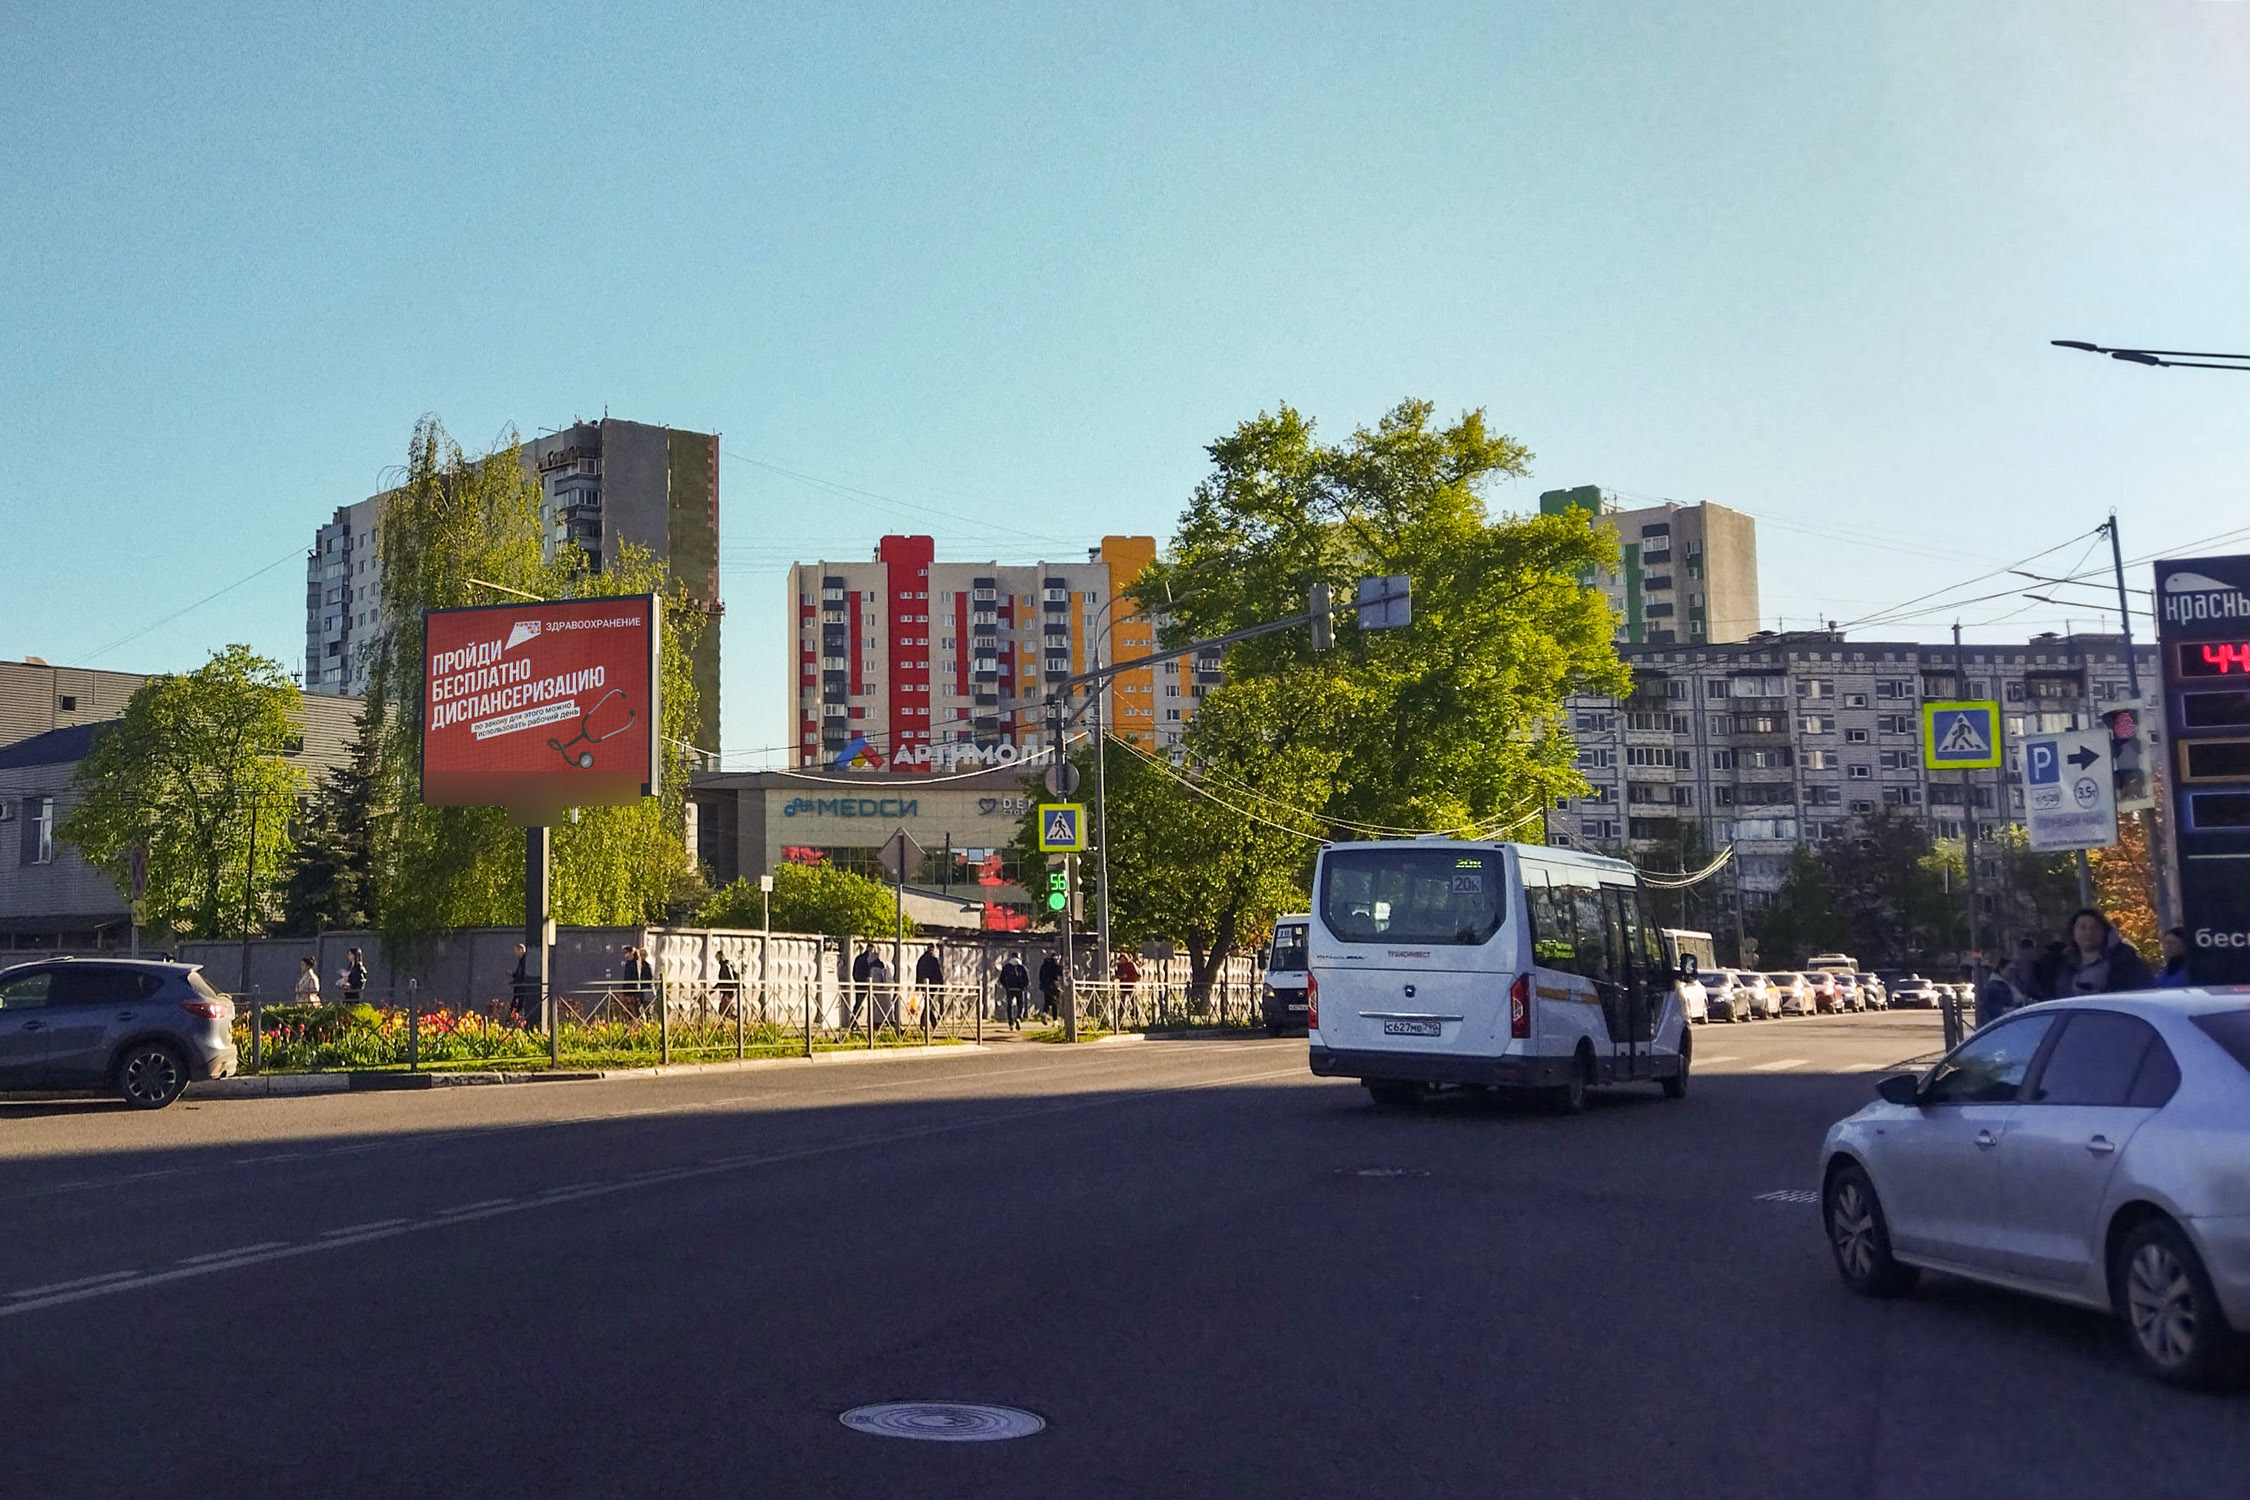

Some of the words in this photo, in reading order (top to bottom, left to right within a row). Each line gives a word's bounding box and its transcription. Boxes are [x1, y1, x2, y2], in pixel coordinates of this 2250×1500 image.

[545, 617, 641, 632] ЗДРАВООХРАНЕНИЕ
[433, 639, 502, 676] ПРОЙДИ
[432, 658, 532, 702] БЕСПЛАТНО
[431, 665, 605, 731] ДИСПАНСЕРИЗАЦИЮ
[478, 721, 527, 737] использовать
[527, 713, 559, 727] рабочий
[560, 709, 579, 720] день
[485, 716, 508, 728] закону
[524, 709, 544, 719] этого
[545, 702, 572, 714] можно
[2033, 747, 2052, 780] P
[1050, 873, 1067, 890] 56
[2195, 928, 2250, 948] бес
